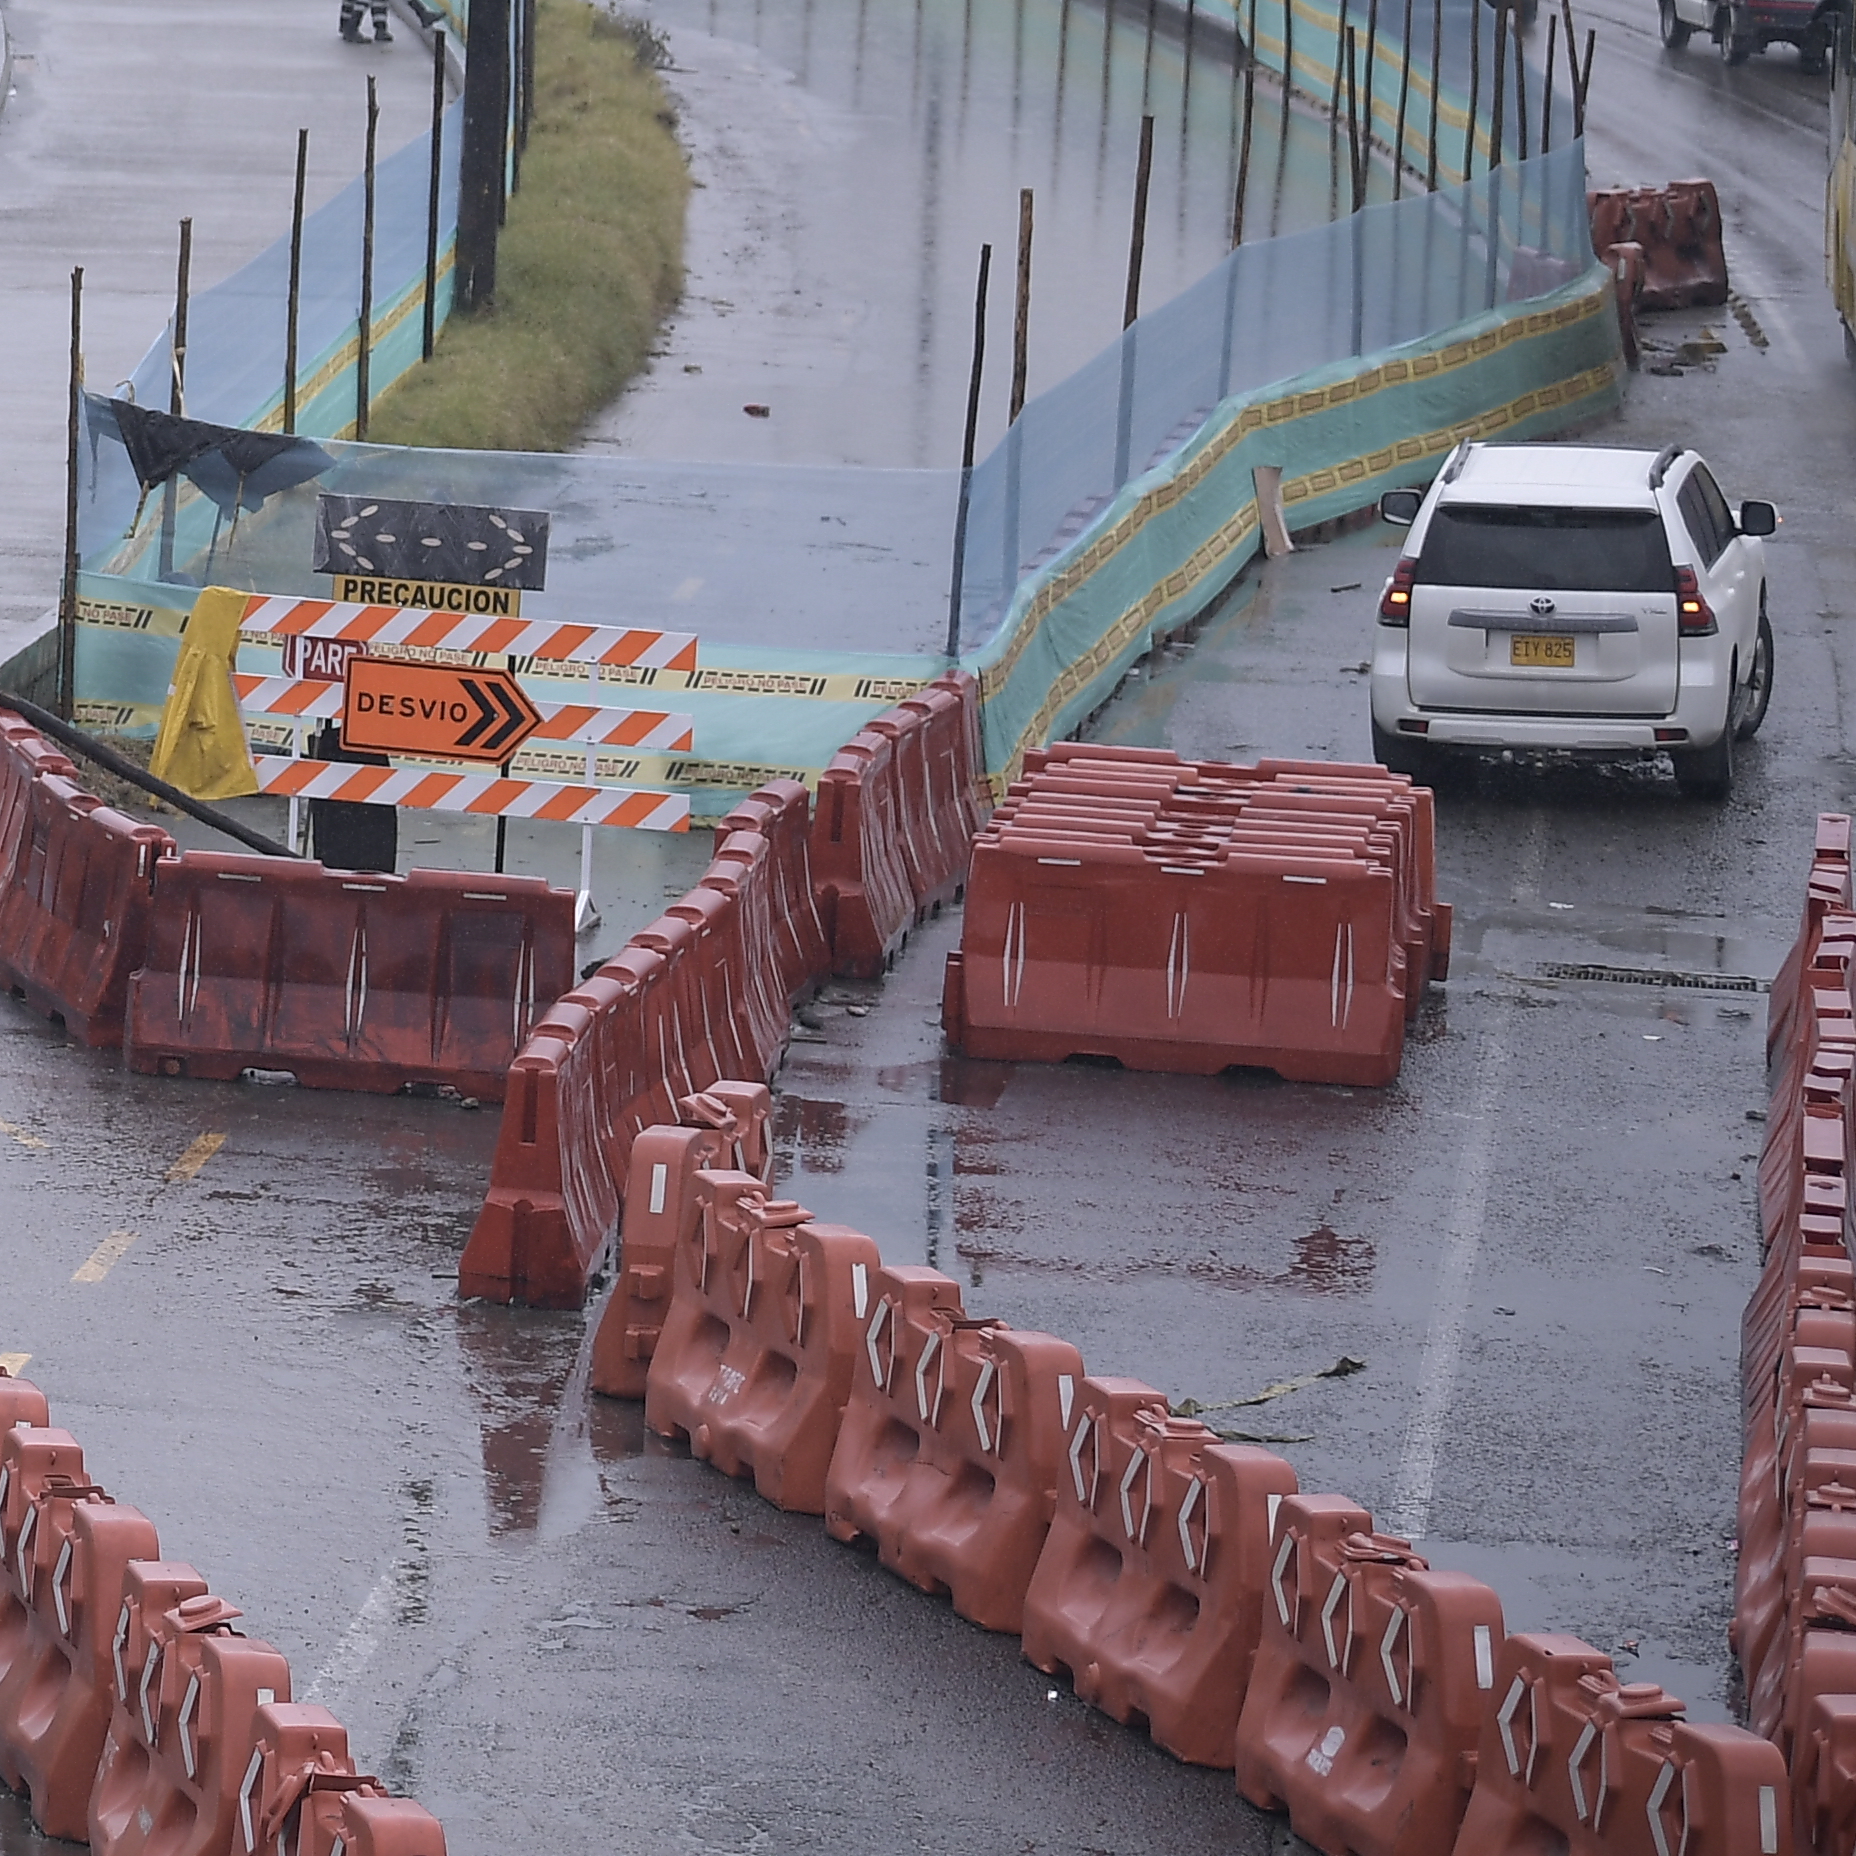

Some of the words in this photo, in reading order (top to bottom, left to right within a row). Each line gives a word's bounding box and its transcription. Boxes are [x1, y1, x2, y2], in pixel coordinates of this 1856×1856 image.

[343, 579, 511, 614] PRECAUCION
[83, 607, 100, 619] NO
[102, 609, 132, 622] PASE
[302, 640, 357, 676] PAR
[419, 648, 436, 659] NO
[439, 650, 469, 663] PASE
[1512, 640, 1539, 657] EIY
[1544, 642, 1572, 659] 825
[534, 661, 586, 674] PELIGRO
[608, 667, 638, 679] PASE
[703, 675, 755, 688] PELIGRO
[757, 678, 775, 689] NO
[776, 679, 806, 692] PASE
[357, 692, 468, 723] DESVIO
[516, 756, 568, 770] PELIGRO
[595, 762, 620, 774] ASE
